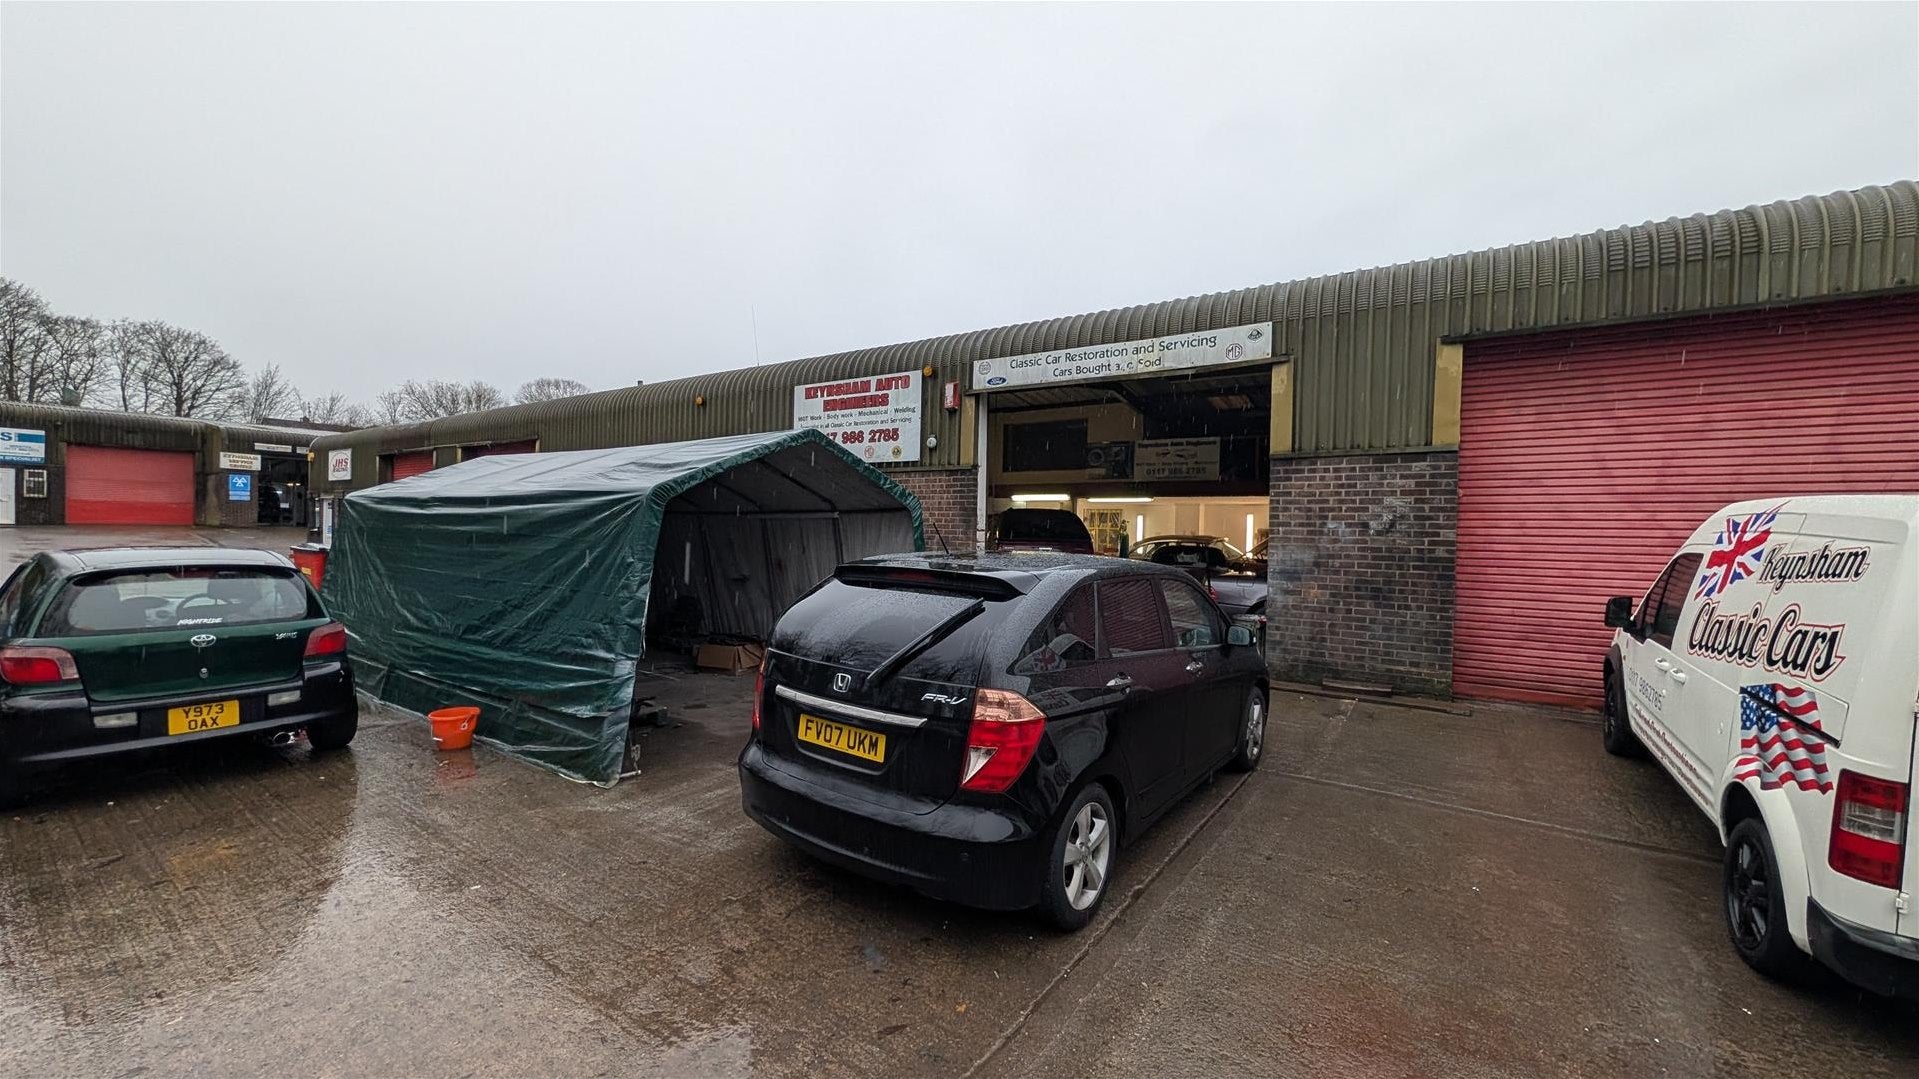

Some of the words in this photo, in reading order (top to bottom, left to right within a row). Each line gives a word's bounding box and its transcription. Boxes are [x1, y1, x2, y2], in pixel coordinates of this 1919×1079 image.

[1009, 356, 1042, 369] Classic
[1045, 354, 1061, 365] Car
[1065, 347, 1128, 363] Restoration
[1131, 342, 1155, 356] and
[1158, 335, 1217, 352] Servicing
[1052, 367, 1073, 377] Cars
[1075, 362, 1111, 375] Bought
[804, 379, 871, 400] KEYNSHAM
[875, 375, 911, 392] AUTO
[823, 393, 889, 412] ENGINEERS
[858, 409, 888, 417] Mechanical
[894, 406, 916, 414] Welding
[868, 428, 900, 443] 2785
[332, 458, 349, 468] JHS
[1757, 541, 1870, 593] Keynsham
[1688, 601, 1769, 664] Classic
[1765, 607, 1840, 677] Cars
[921, 693, 967, 705] FR-V
[182, 703, 225, 719] Y973
[188, 716, 219, 730] OAX
[804, 719, 844, 746] FV07
[846, 730, 879, 757] UKM
